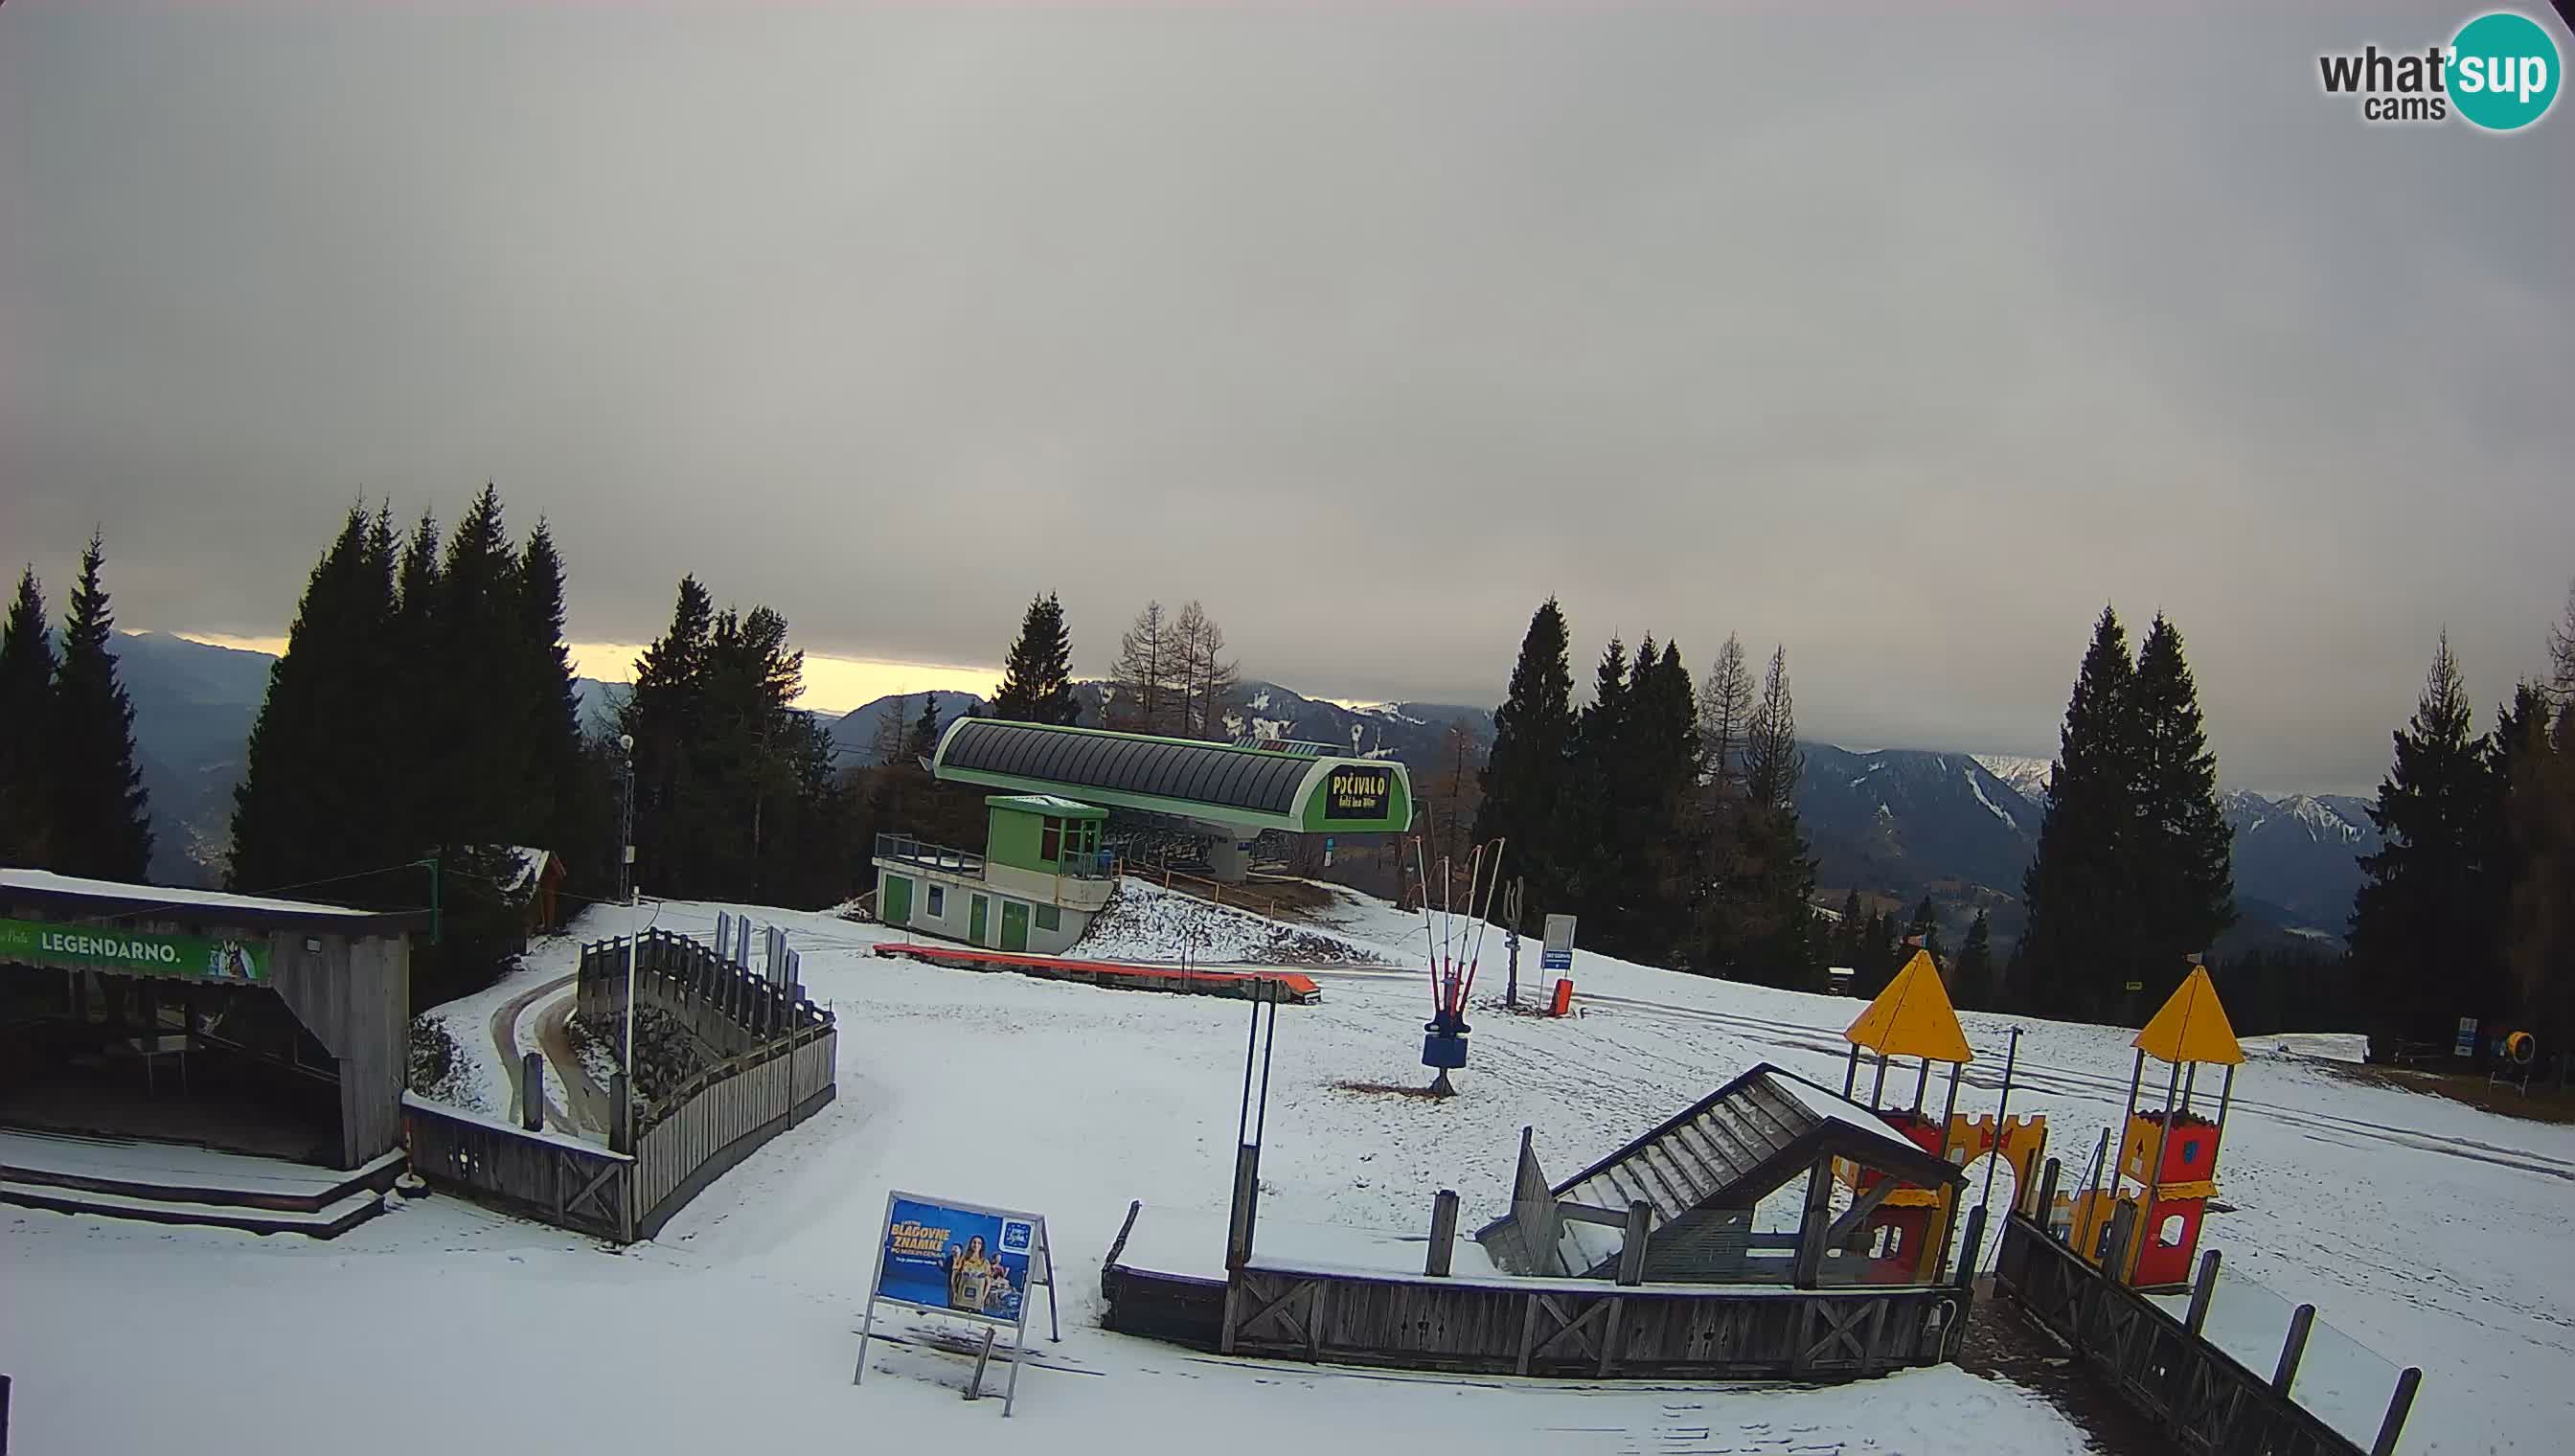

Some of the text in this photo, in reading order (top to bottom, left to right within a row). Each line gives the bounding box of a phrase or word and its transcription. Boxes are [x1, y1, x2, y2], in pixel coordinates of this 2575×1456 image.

[41, 932, 182, 964] LEGENDARNO.
[891, 1223, 951, 1240] BLAGOVNE
[893, 1236, 944, 1252] ZNAMKE
